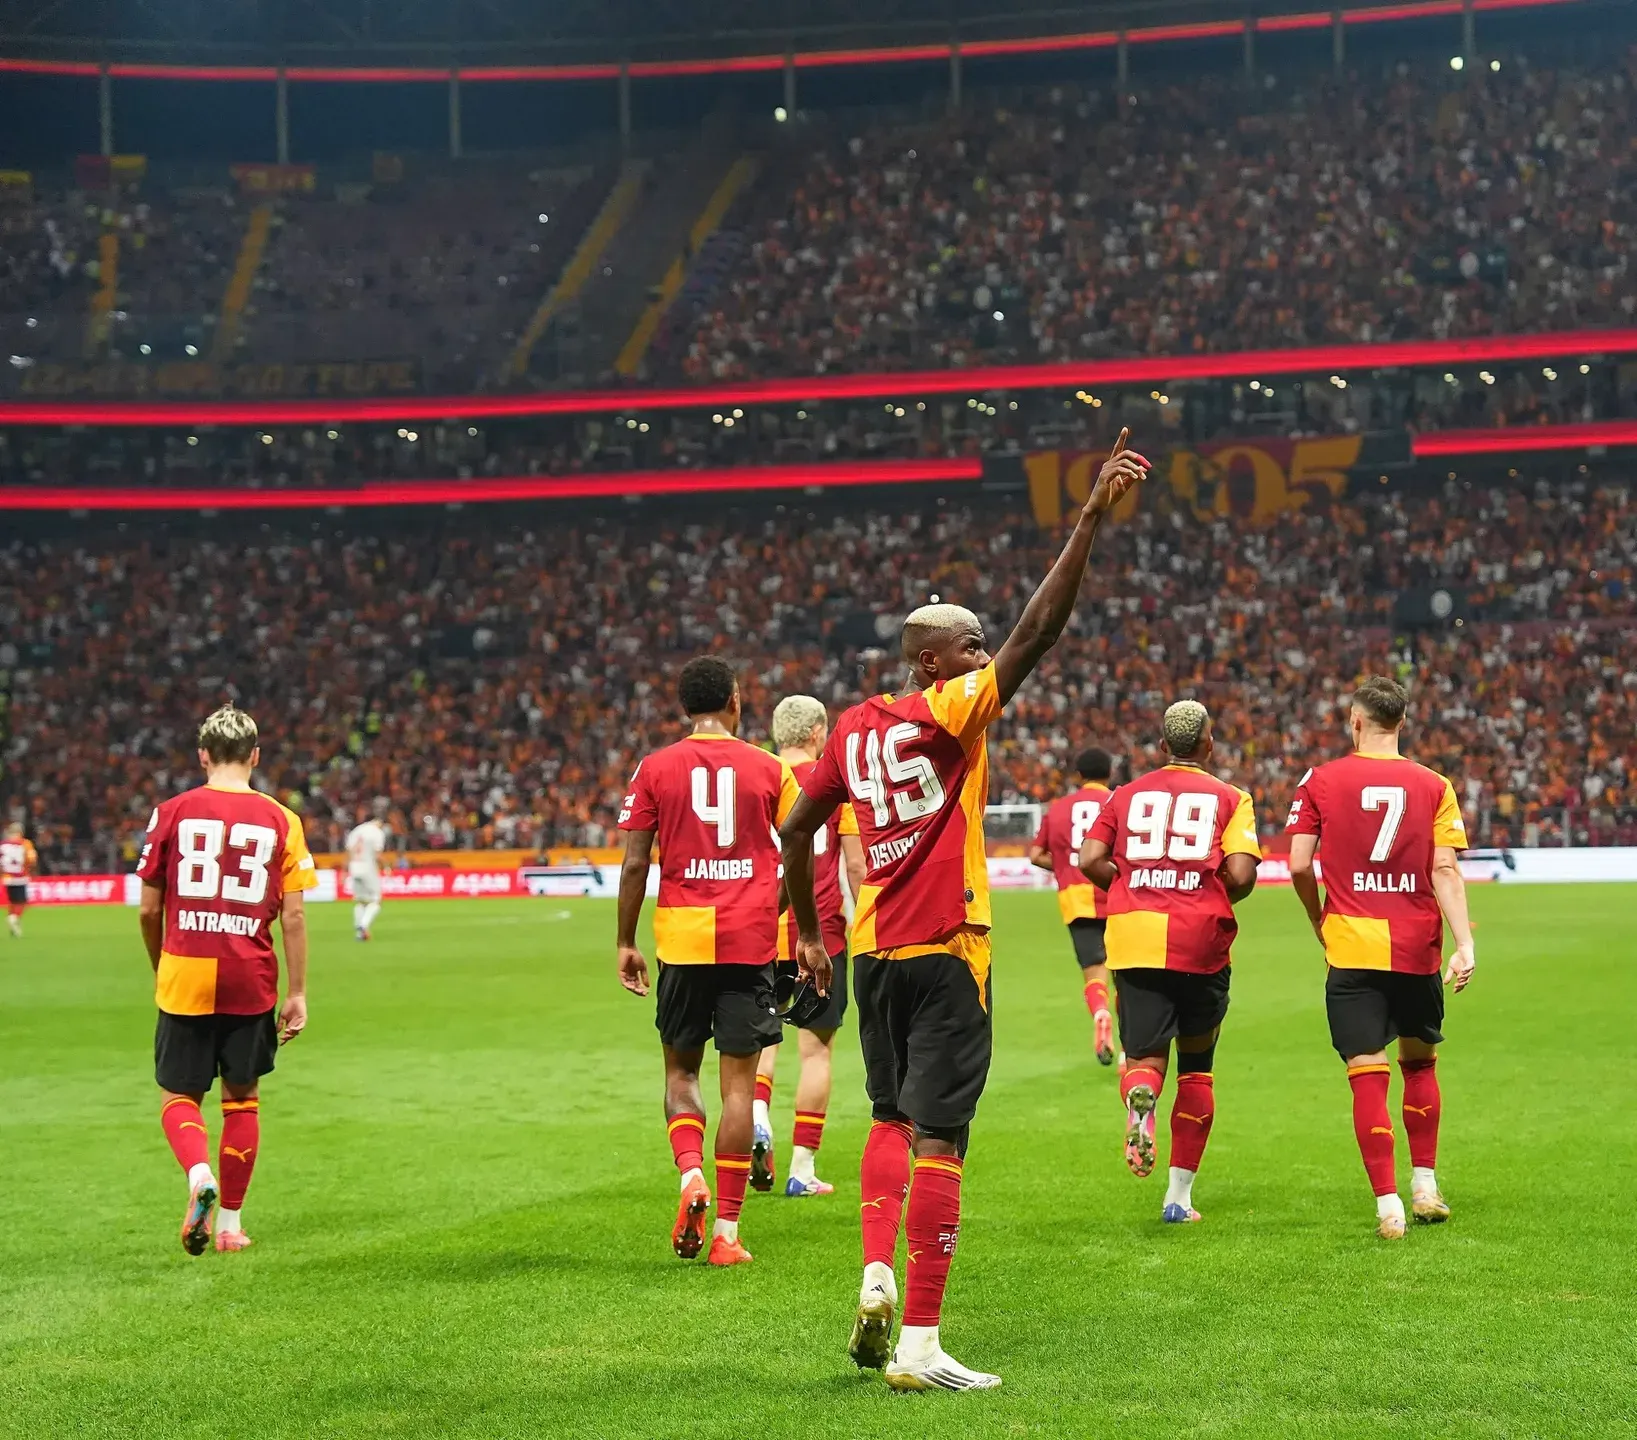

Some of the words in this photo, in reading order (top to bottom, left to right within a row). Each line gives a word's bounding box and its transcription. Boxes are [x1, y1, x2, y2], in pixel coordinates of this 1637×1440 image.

[691, 767, 736, 848] 4
[846, 722, 947, 828] 45
[1126, 791, 1218, 860] 99
[1361, 786, 1407, 863] 7
[177, 818, 277, 905] 83
[685, 858, 753, 880] JAKOBS
[1128, 868, 1177, 888] MARIO
[1178, 871, 1203, 891] JR.
[1353, 872, 1416, 893] SALLAI
[178, 909, 261, 937] BATRAKOV
